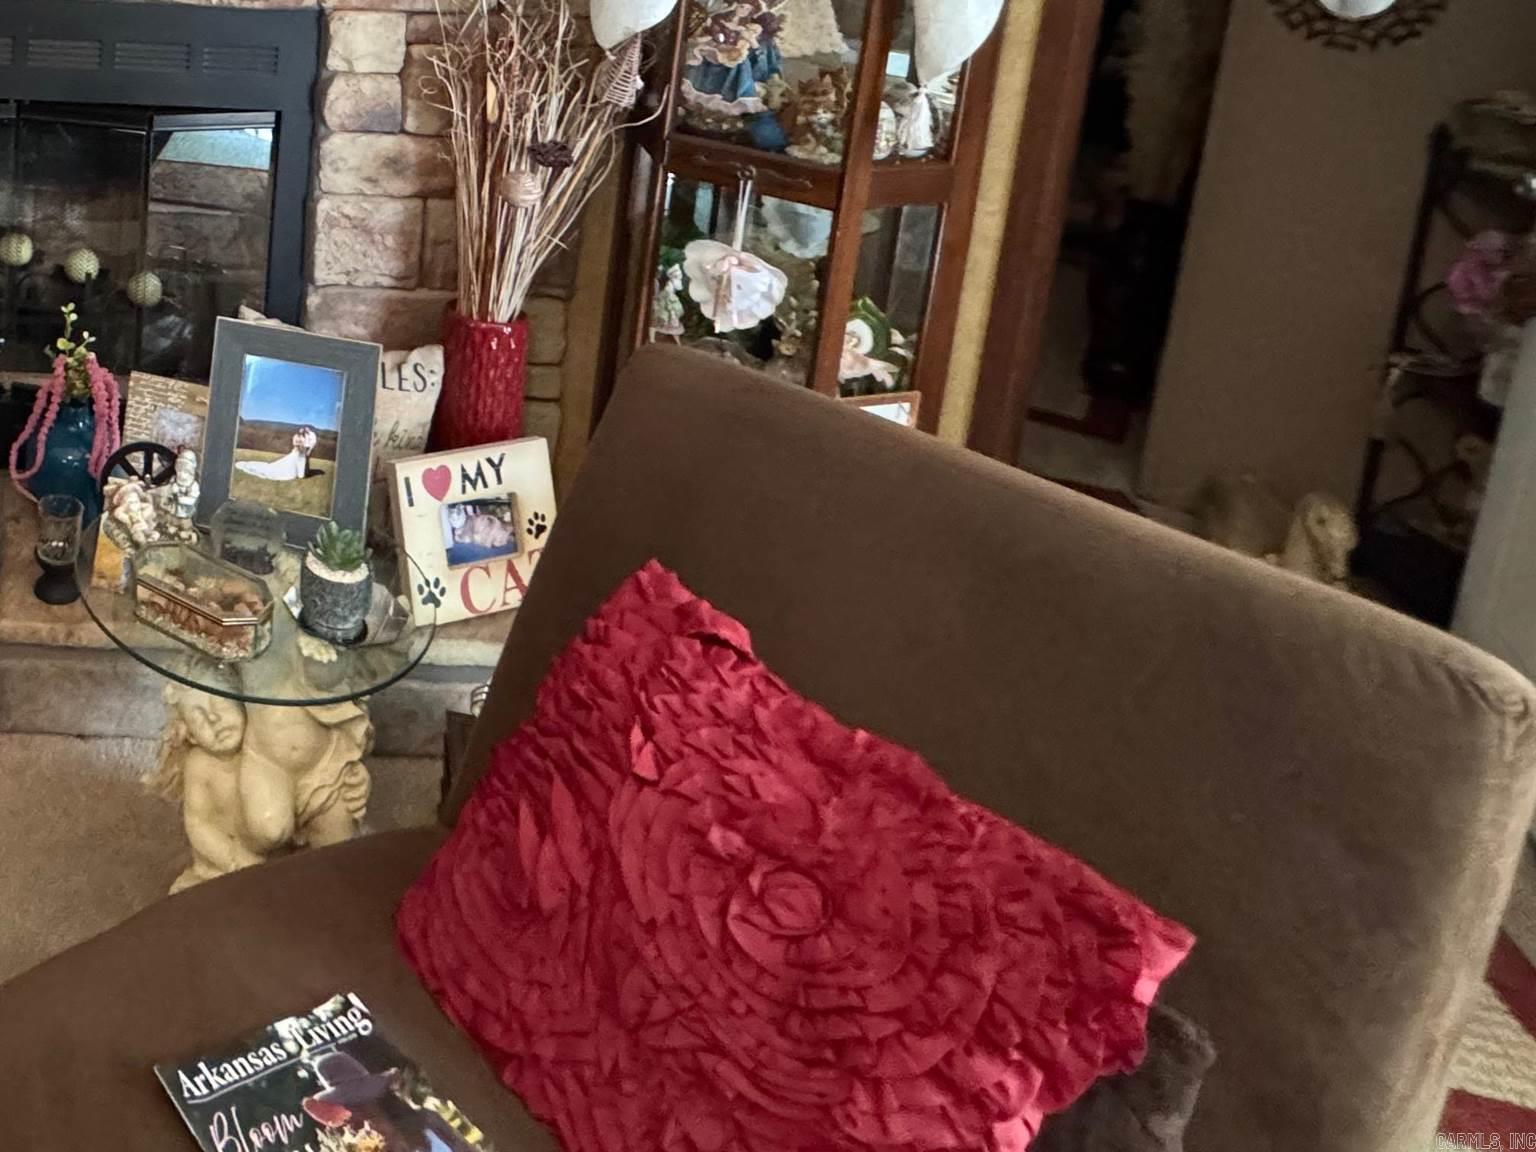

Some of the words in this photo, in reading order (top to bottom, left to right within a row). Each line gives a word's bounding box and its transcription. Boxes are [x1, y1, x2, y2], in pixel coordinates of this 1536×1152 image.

[404, 477, 414, 508] I
[460, 453, 507, 496] MY
[177, 1041, 288, 1098] Arkansas
[291, 1007, 373, 1049] Living
[209, 1105, 304, 1152] Bloom
